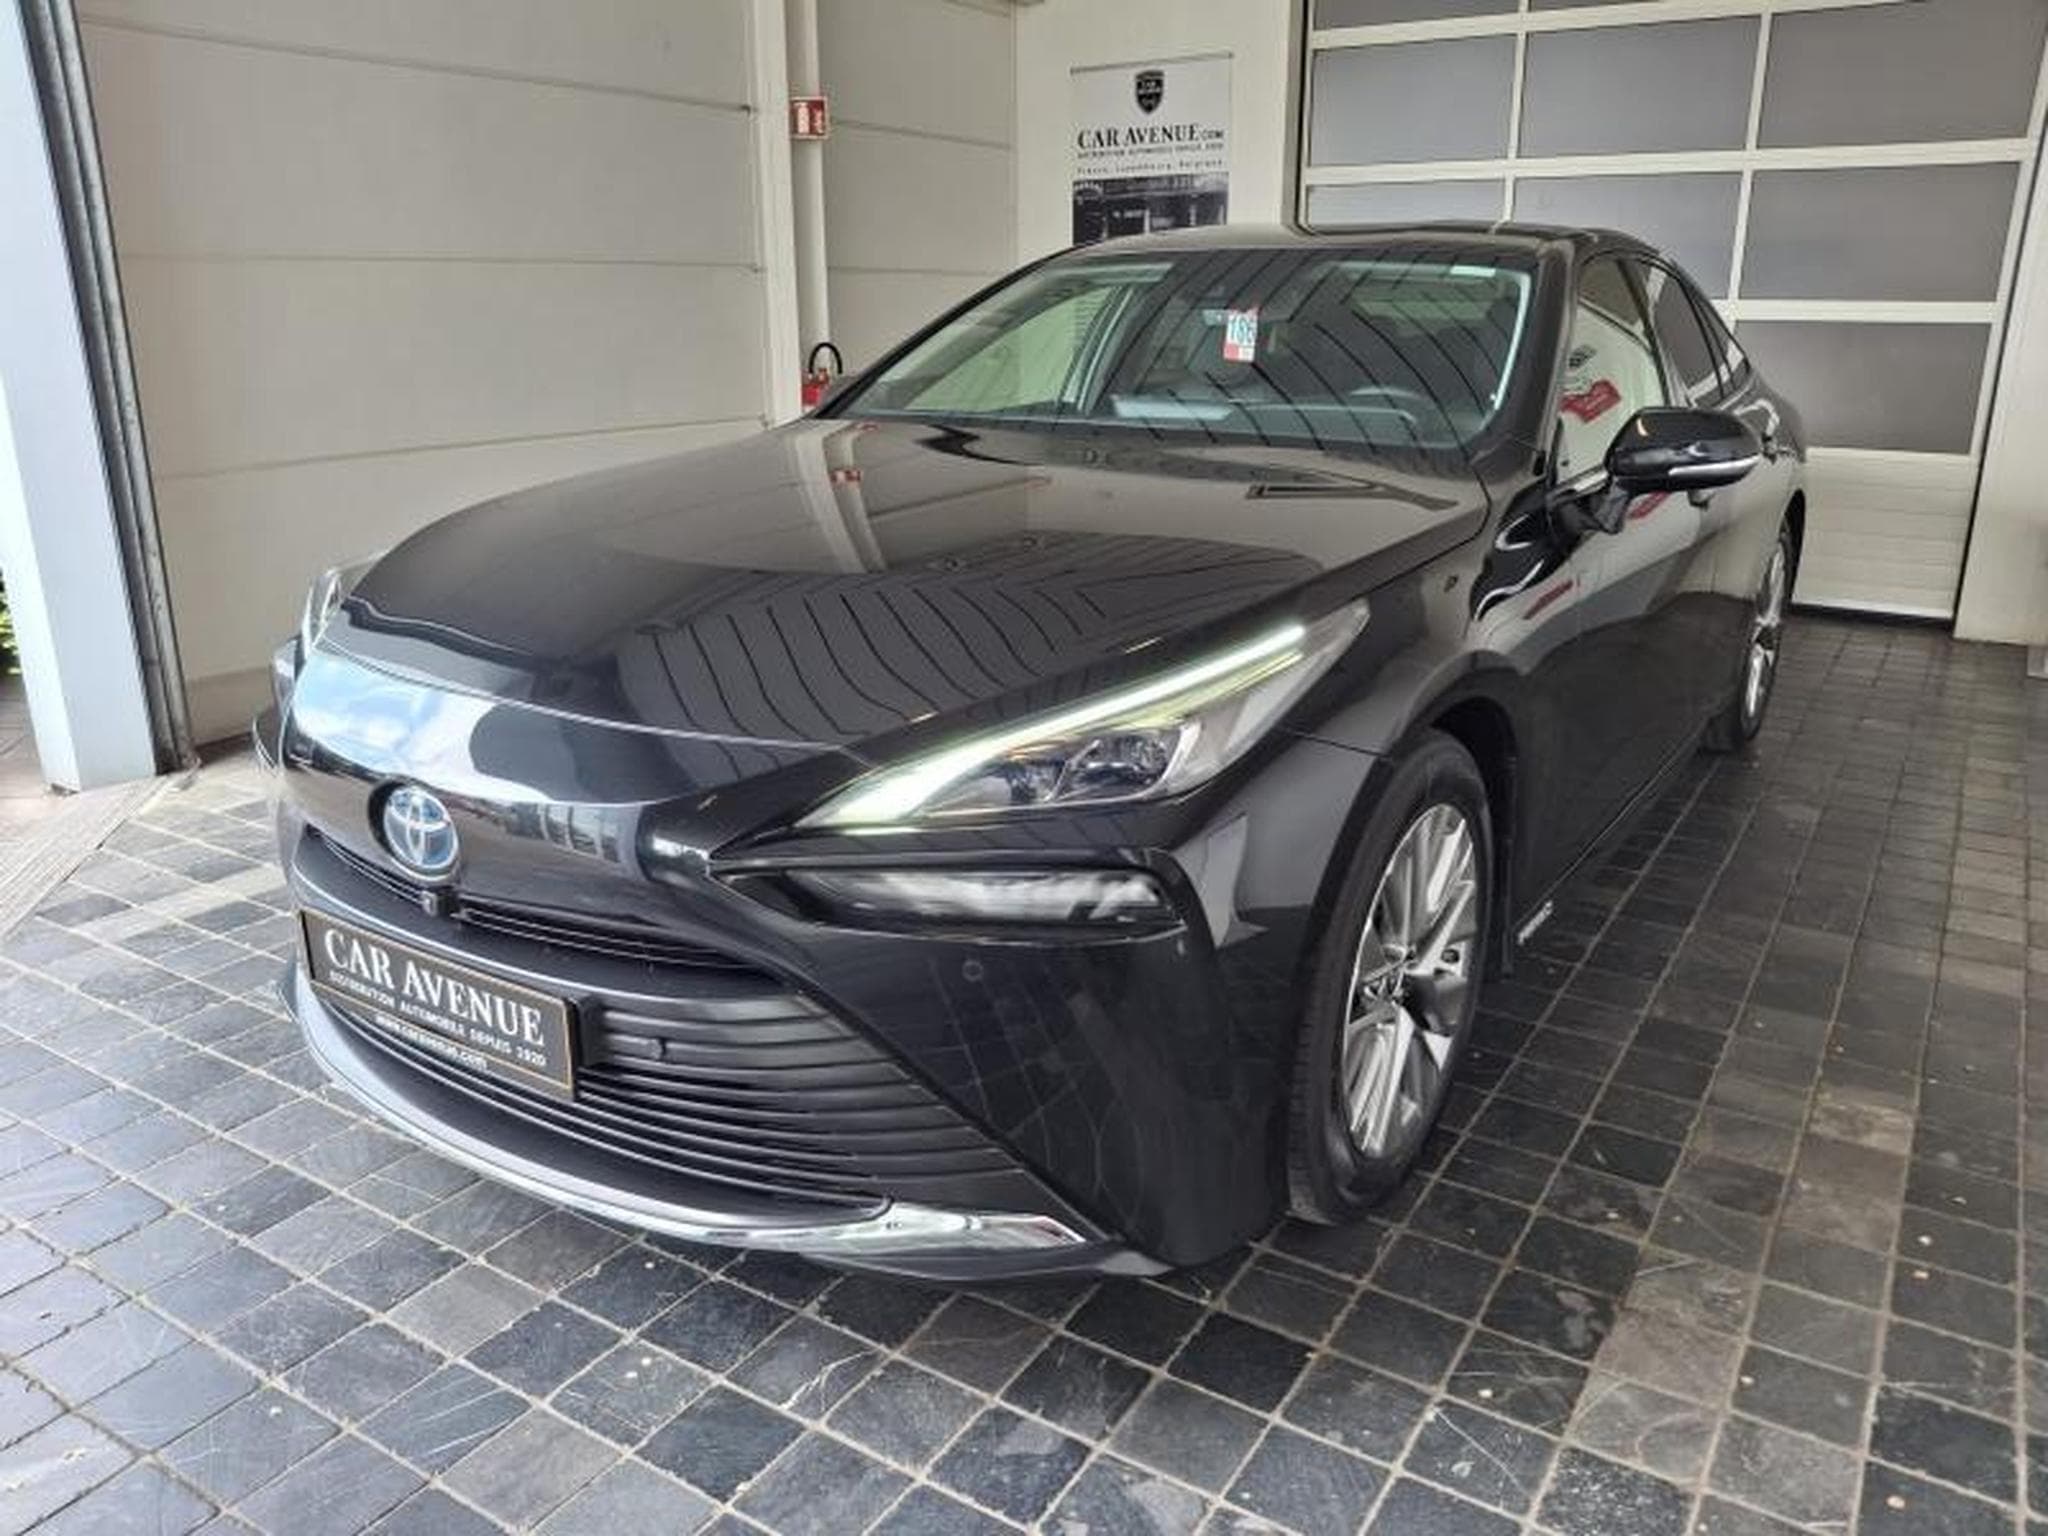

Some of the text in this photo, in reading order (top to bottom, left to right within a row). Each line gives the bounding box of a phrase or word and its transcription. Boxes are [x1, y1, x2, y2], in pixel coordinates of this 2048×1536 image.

[1077, 128, 1119, 149] CAR
[325, 930, 544, 1046] CAR AVENUE
